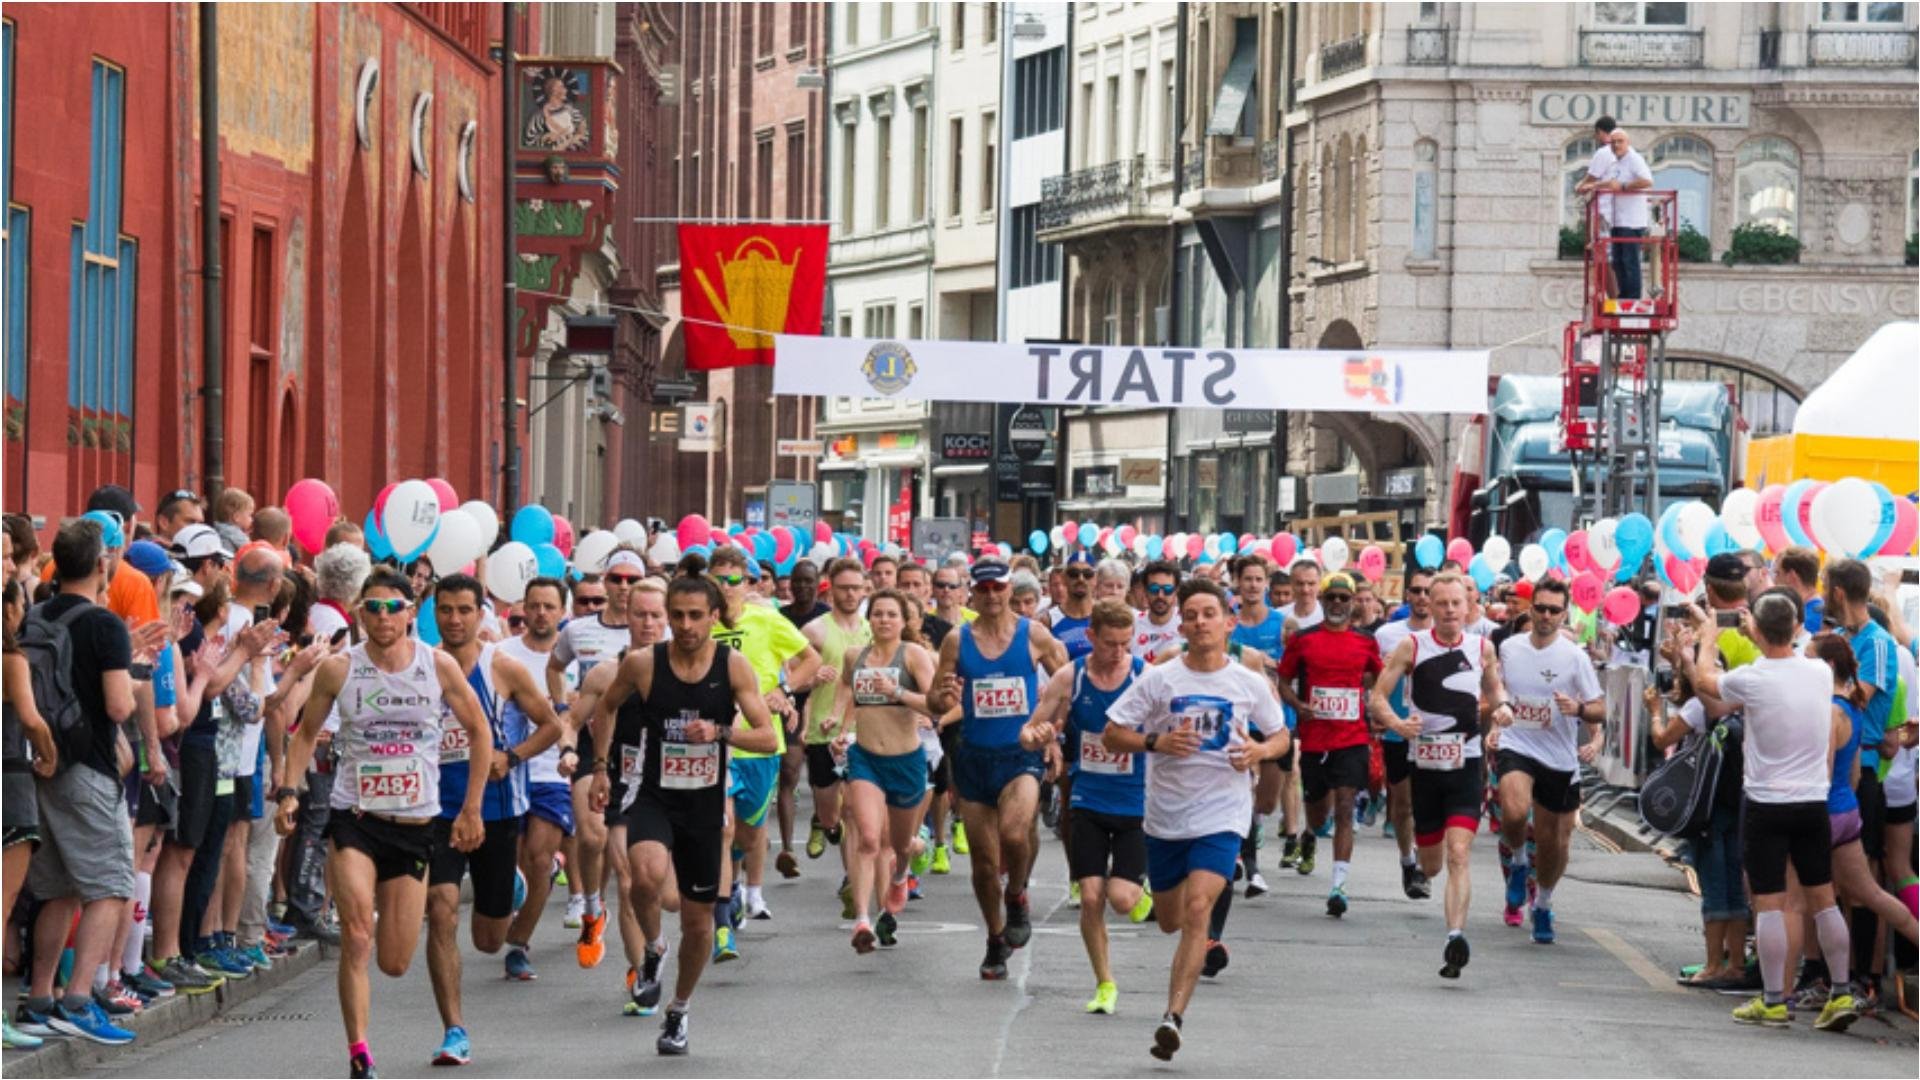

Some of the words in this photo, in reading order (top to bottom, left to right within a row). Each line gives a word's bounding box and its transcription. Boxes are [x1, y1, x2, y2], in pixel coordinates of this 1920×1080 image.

[1539, 93, 1743, 124] COIFFURE
[1716, 284, 1918, 314] LEBENSVE
[945, 435, 991, 449] KOCH
[370, 743, 414, 756] WOD
[1418, 745, 1459, 760] 2403
[666, 758, 714, 775] 2368
[362, 774, 418, 796] 2482
